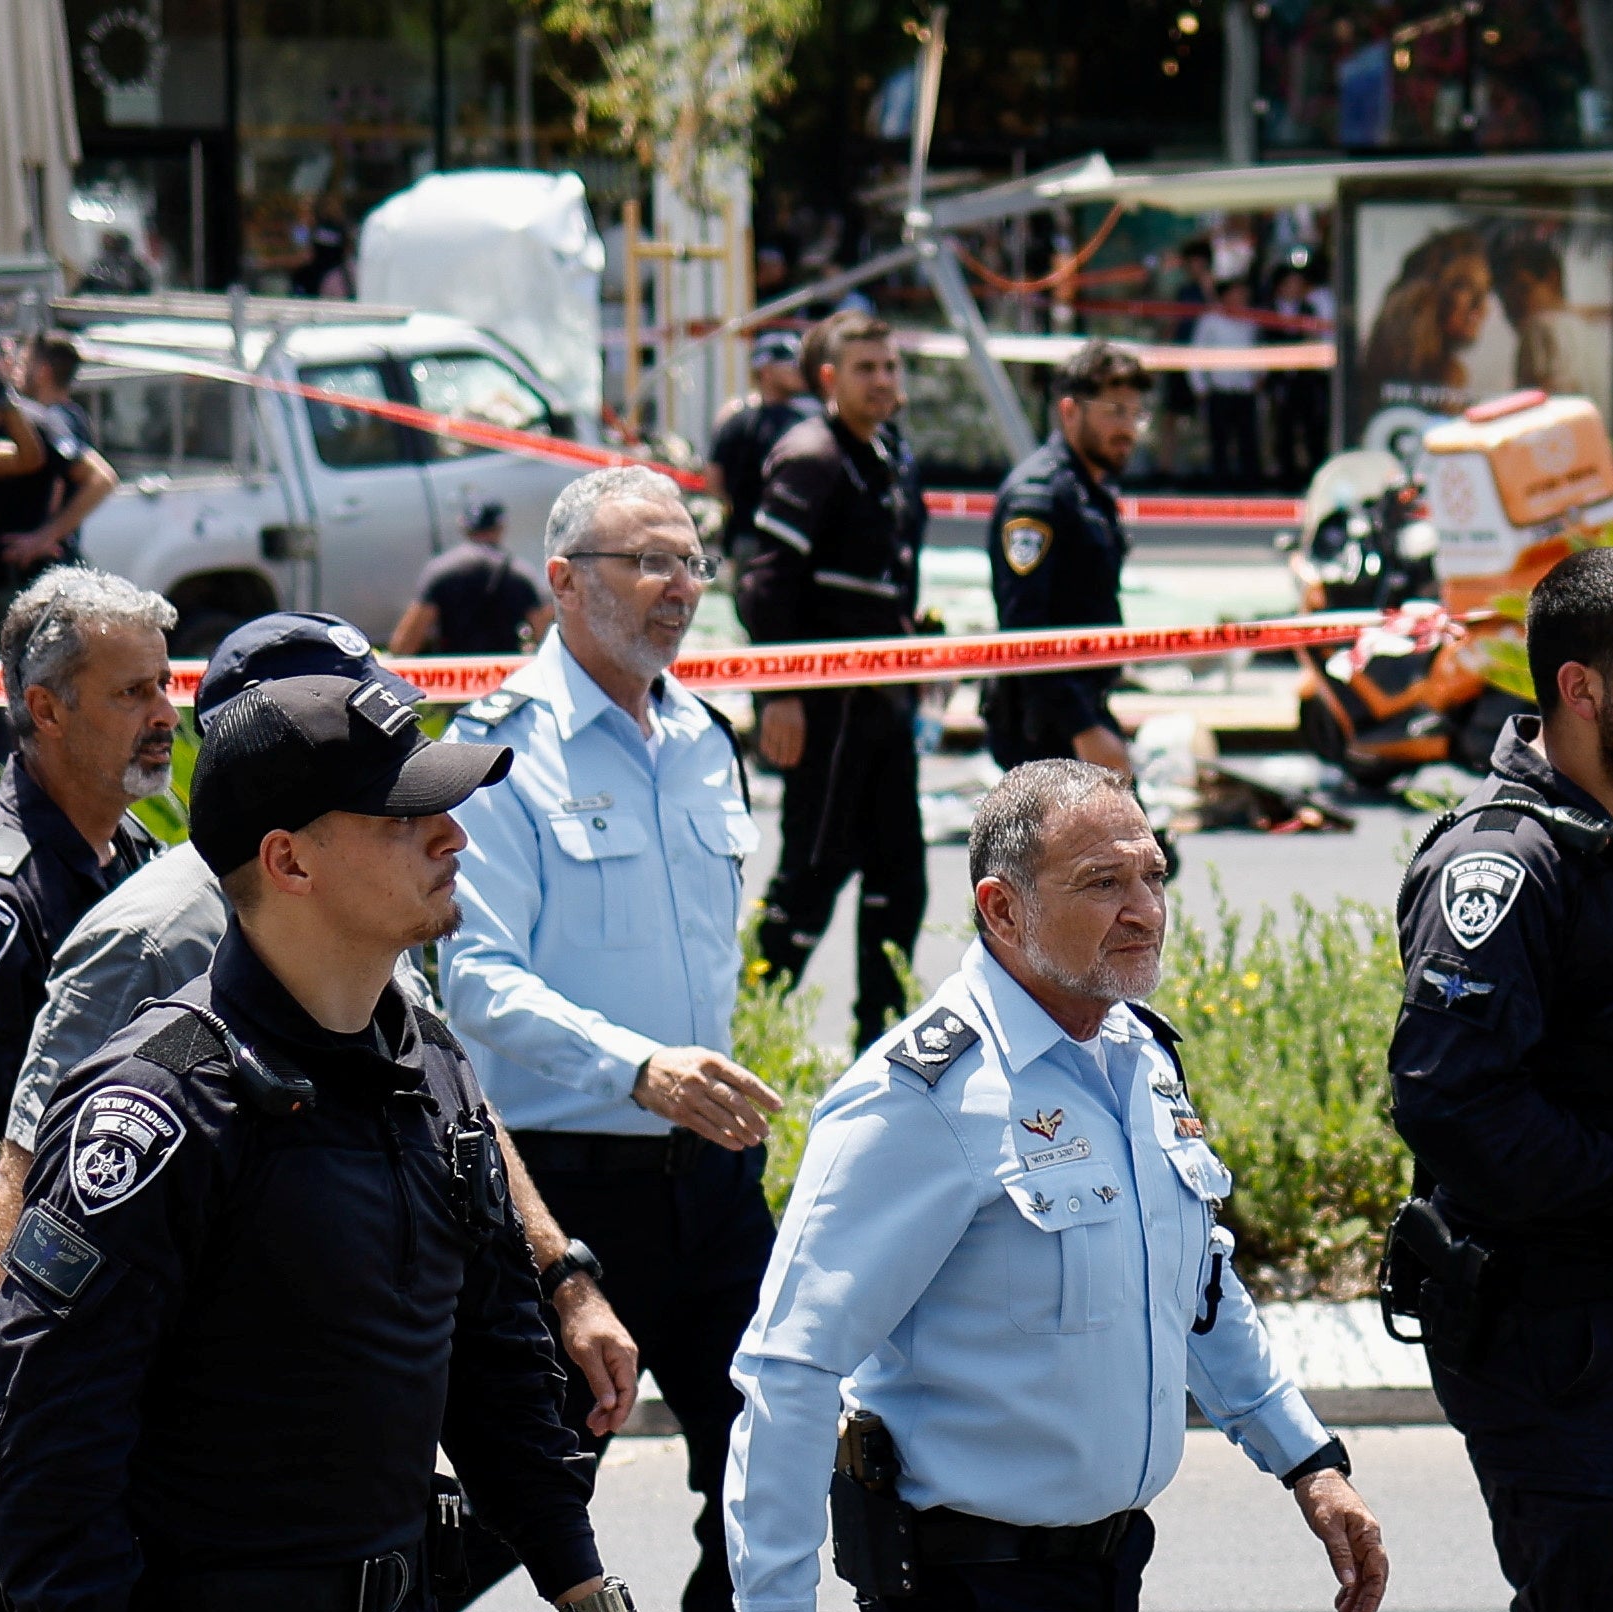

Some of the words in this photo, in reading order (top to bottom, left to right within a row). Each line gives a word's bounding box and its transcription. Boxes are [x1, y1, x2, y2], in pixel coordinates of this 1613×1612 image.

[758, 654, 816, 676] מעבר
[821, 651, 851, 676] אין
[855, 646, 933, 669] ישראל
[92, 1097, 134, 1110] ישראל
[130, 1101, 175, 1138] משטרת
[36, 1218, 57, 1237] ישראל
[60, 1238, 89, 1260] משטרת
